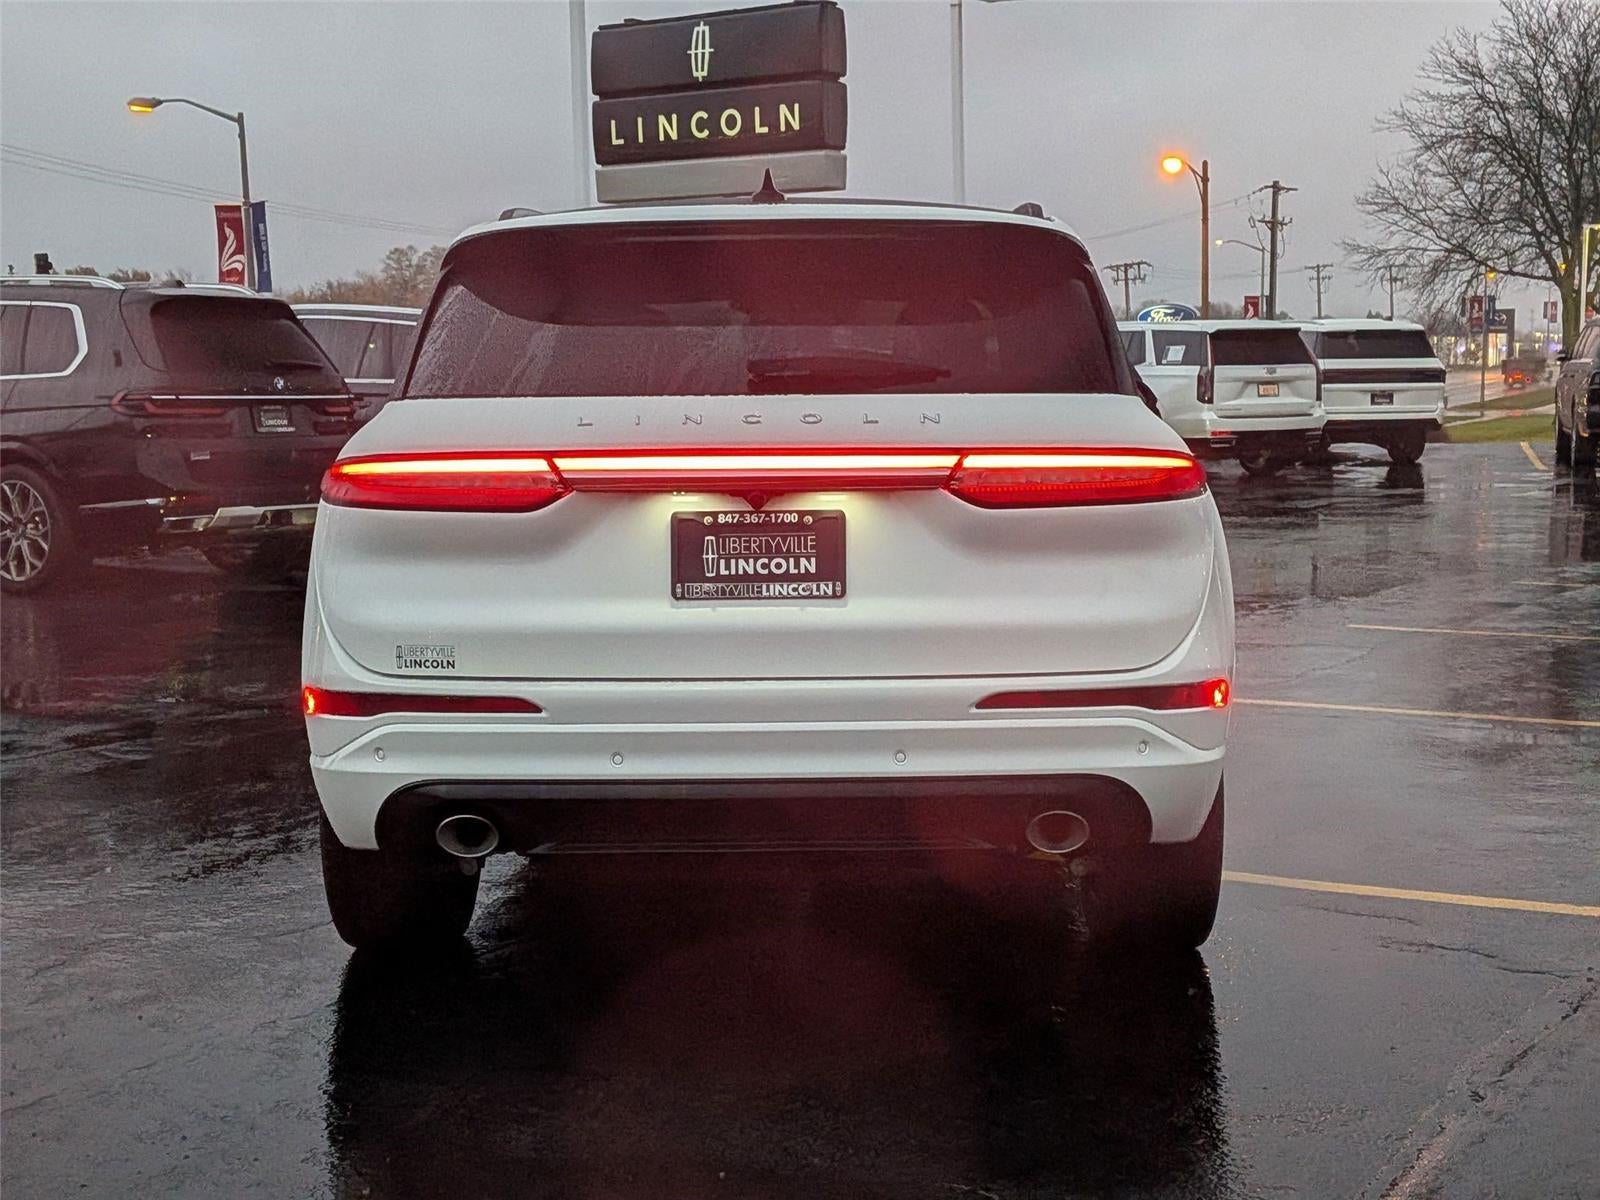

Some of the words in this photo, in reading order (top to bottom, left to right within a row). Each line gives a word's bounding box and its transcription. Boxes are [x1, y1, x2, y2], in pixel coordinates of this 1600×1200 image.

[610, 103, 800, 145] LINCOLN
[577, 412, 941, 426] LINCOLN
[717, 513, 799, 524] 847-367-1700
[719, 536, 817, 554] LIBERTYVILLE
[719, 557, 817, 576] LINCOLN
[403, 647, 456, 657] LIBERTYVILLE
[404, 659, 456, 669] LINCOLN
